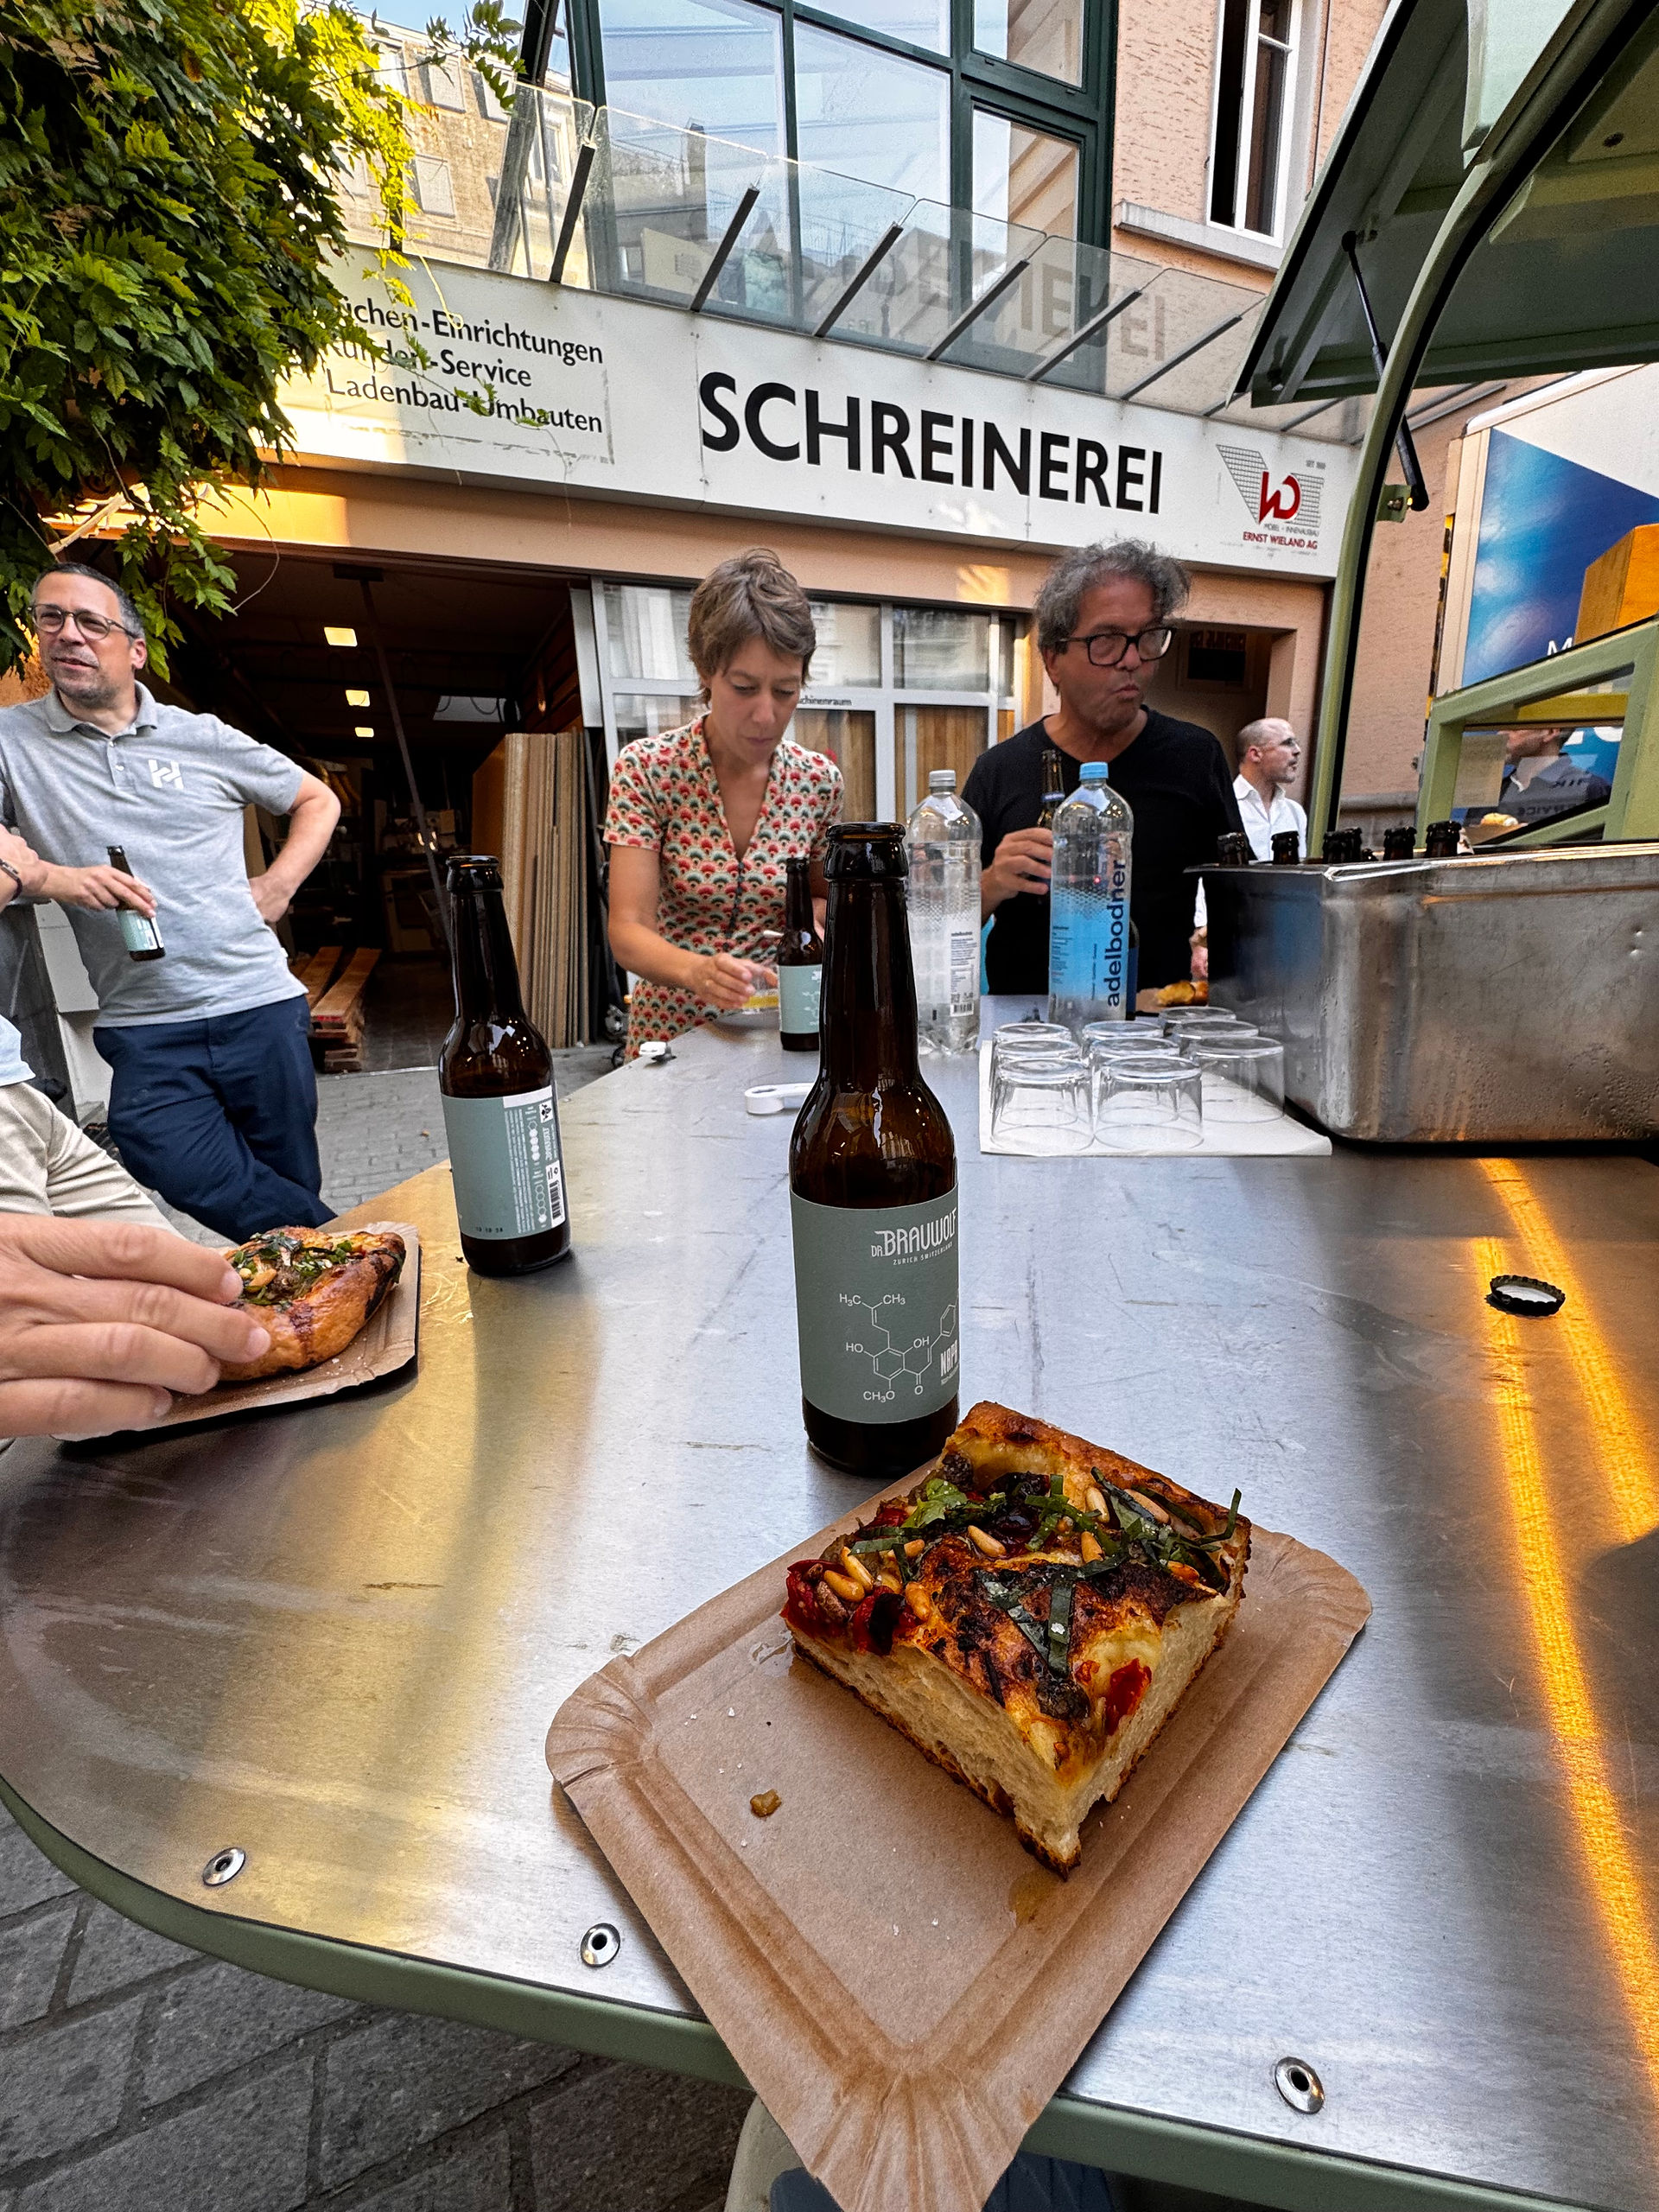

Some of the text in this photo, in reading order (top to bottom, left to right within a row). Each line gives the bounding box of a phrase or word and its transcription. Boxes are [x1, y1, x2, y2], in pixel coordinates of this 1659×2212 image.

[344, 296, 603, 366] chen-Einrichtungen
[699, 371, 1162, 515] SCHREINEREI
[1243, 531, 1319, 550] ERNST WIELAND AG
[1103, 859, 1126, 1007] adelbodner
[874, 1206, 957, 1256] BRAUWOLF
